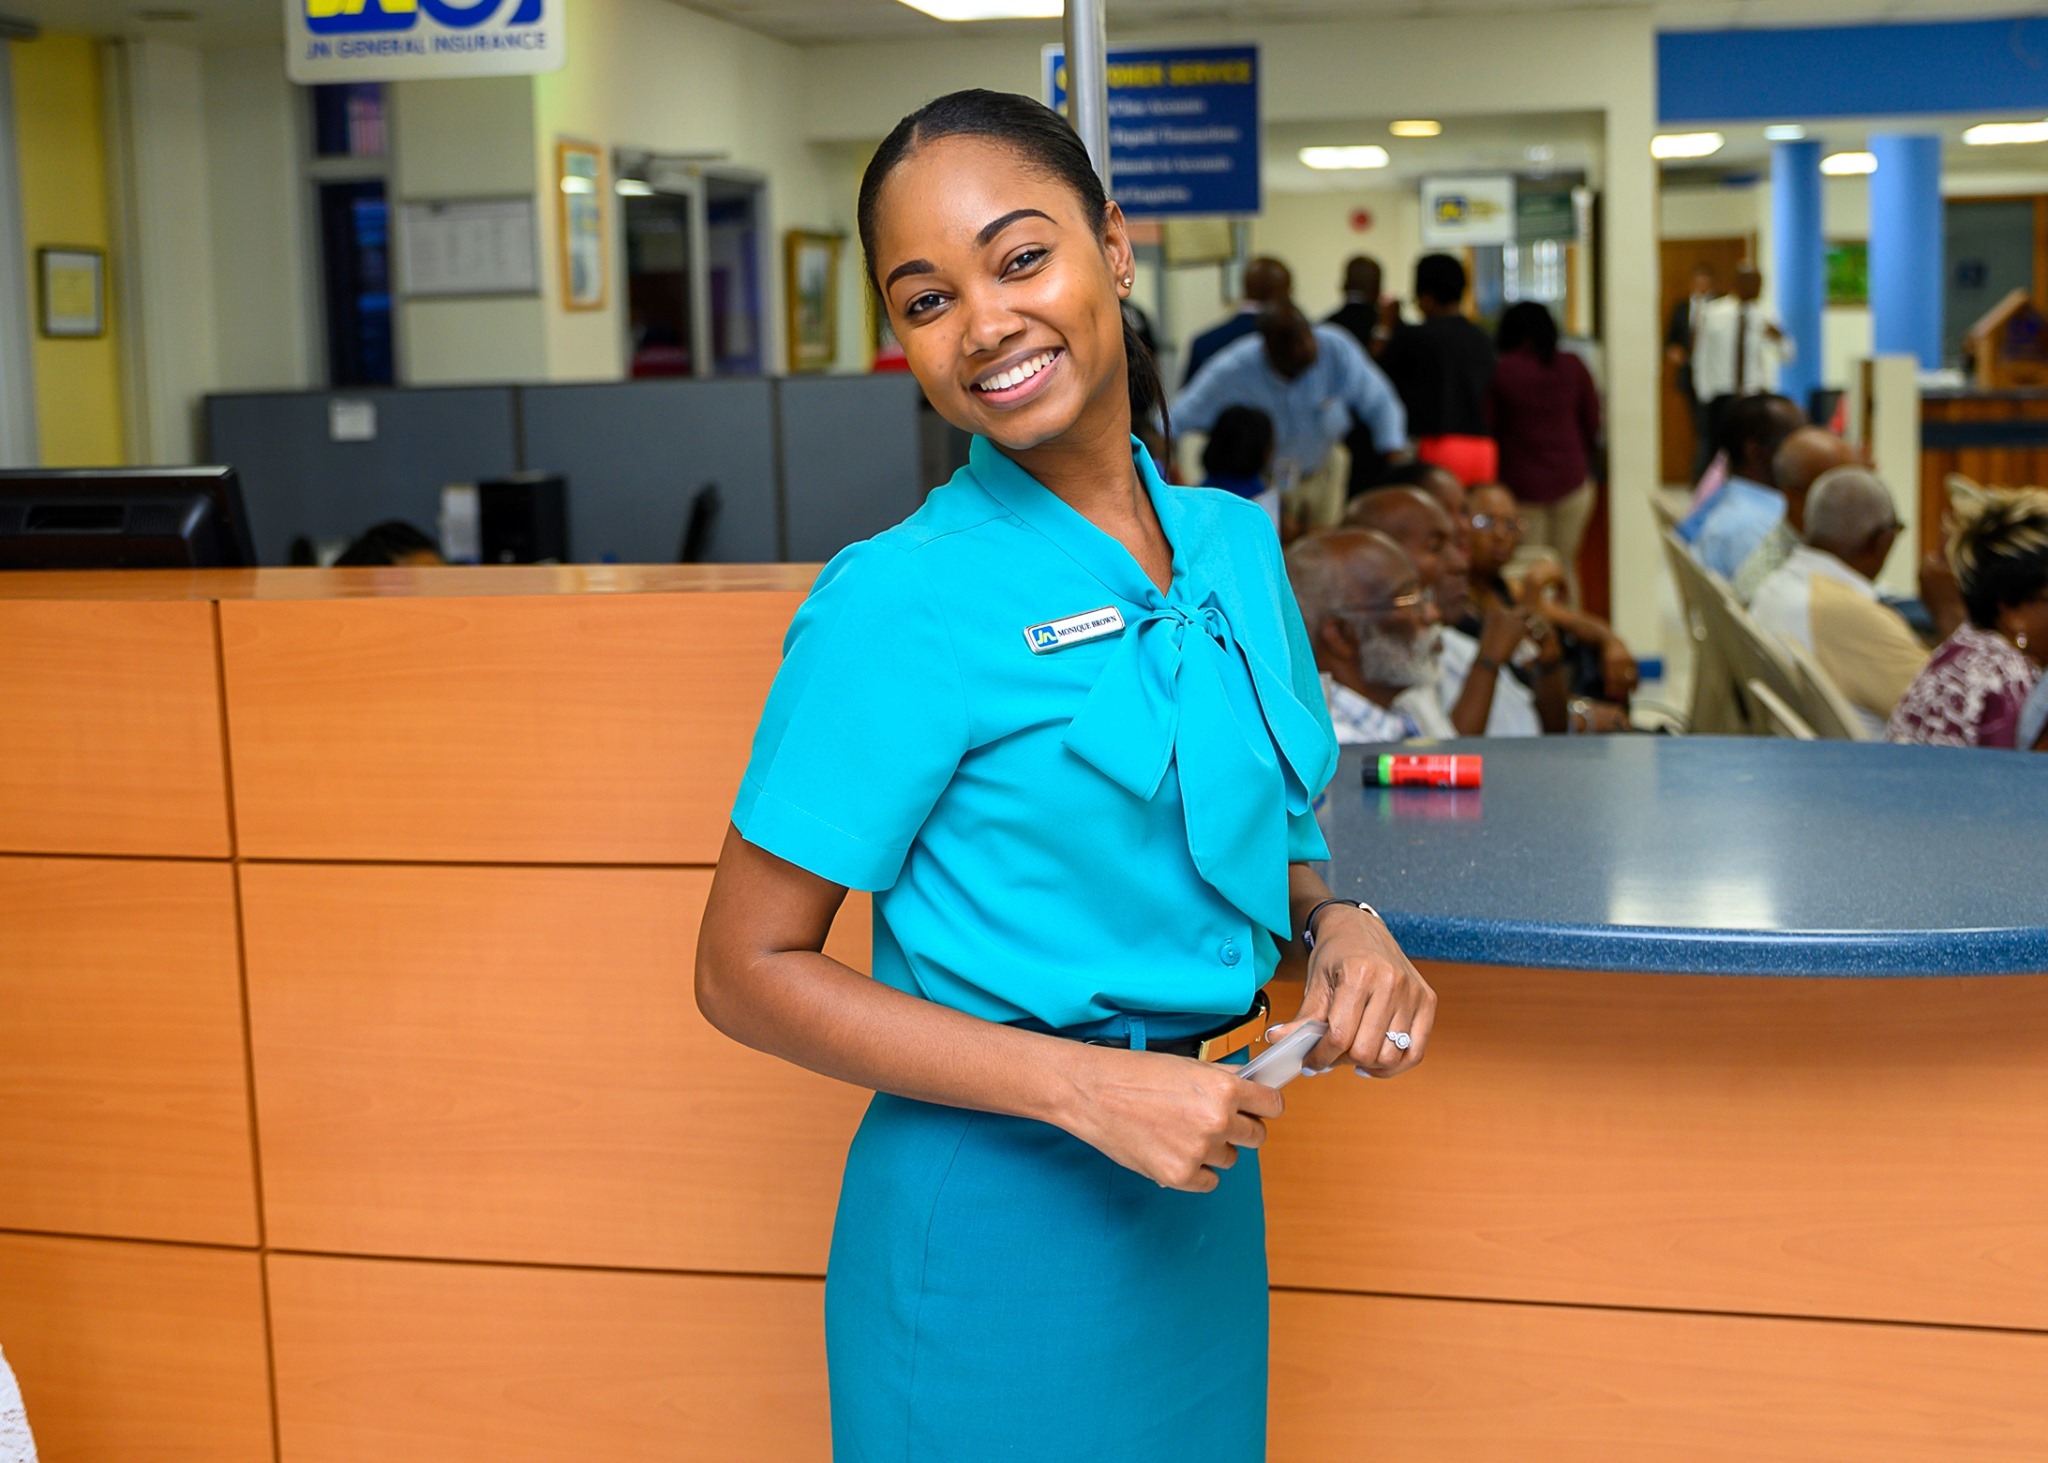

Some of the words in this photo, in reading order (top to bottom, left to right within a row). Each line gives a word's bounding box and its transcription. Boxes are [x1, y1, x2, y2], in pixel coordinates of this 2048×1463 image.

[306, 42, 331, 60] JN
[336, 38, 425, 57] GENERAL
[434, 33, 546, 53] INSURANCE
[1168, 59, 1251, 85] SERVICE
[1058, 623, 1091, 637] MONIQUE
[1092, 616, 1117, 628] BROWN
